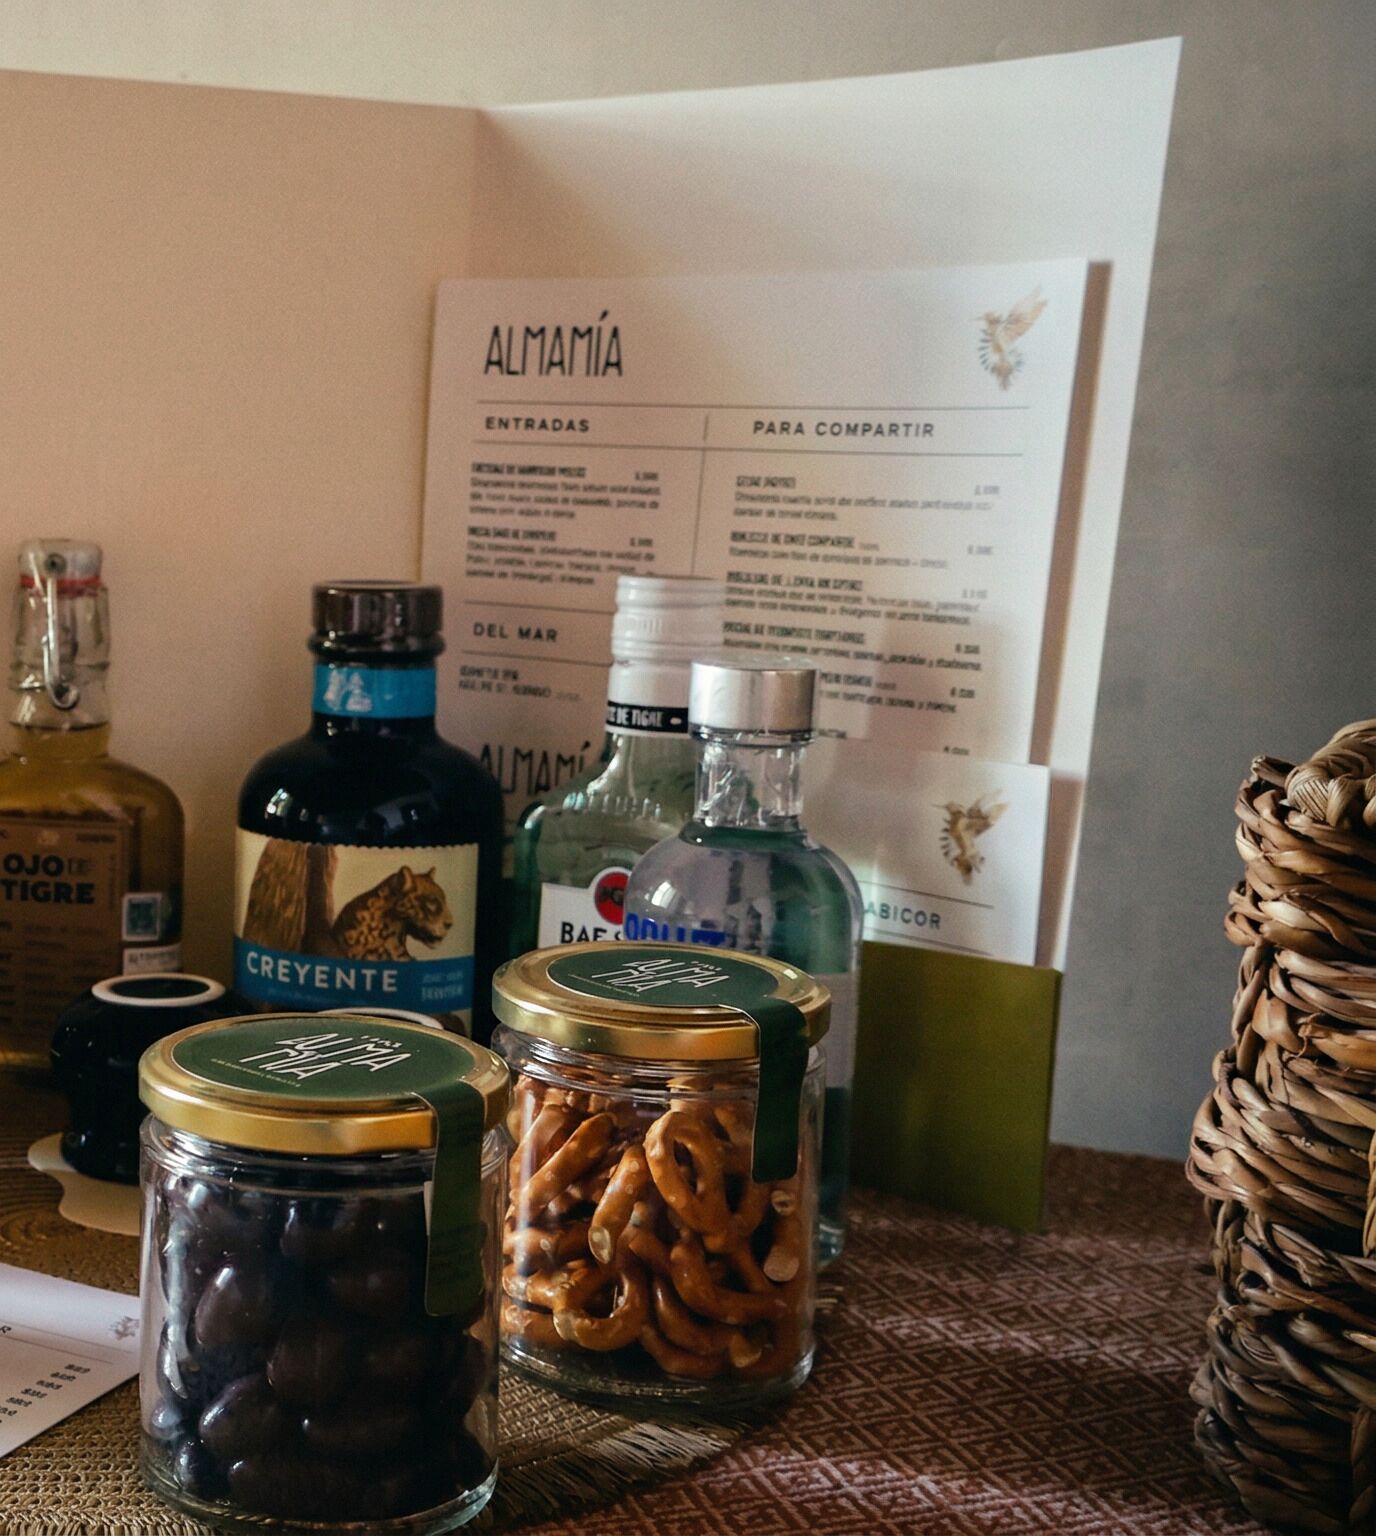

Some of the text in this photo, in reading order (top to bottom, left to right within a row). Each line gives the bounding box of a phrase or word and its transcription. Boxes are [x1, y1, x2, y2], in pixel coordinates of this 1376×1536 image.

[484, 309, 624, 377] ALMAMÍA
[485, 416, 591, 433] ENTRADAS
[753, 421, 934, 440] PARA COMPARTIR
[473, 622, 559, 643] DEL MAR
[2, 852, 65, 877] OJO
[0, 878, 96, 905] TIGRE
[246, 951, 399, 993] CREYENTE
